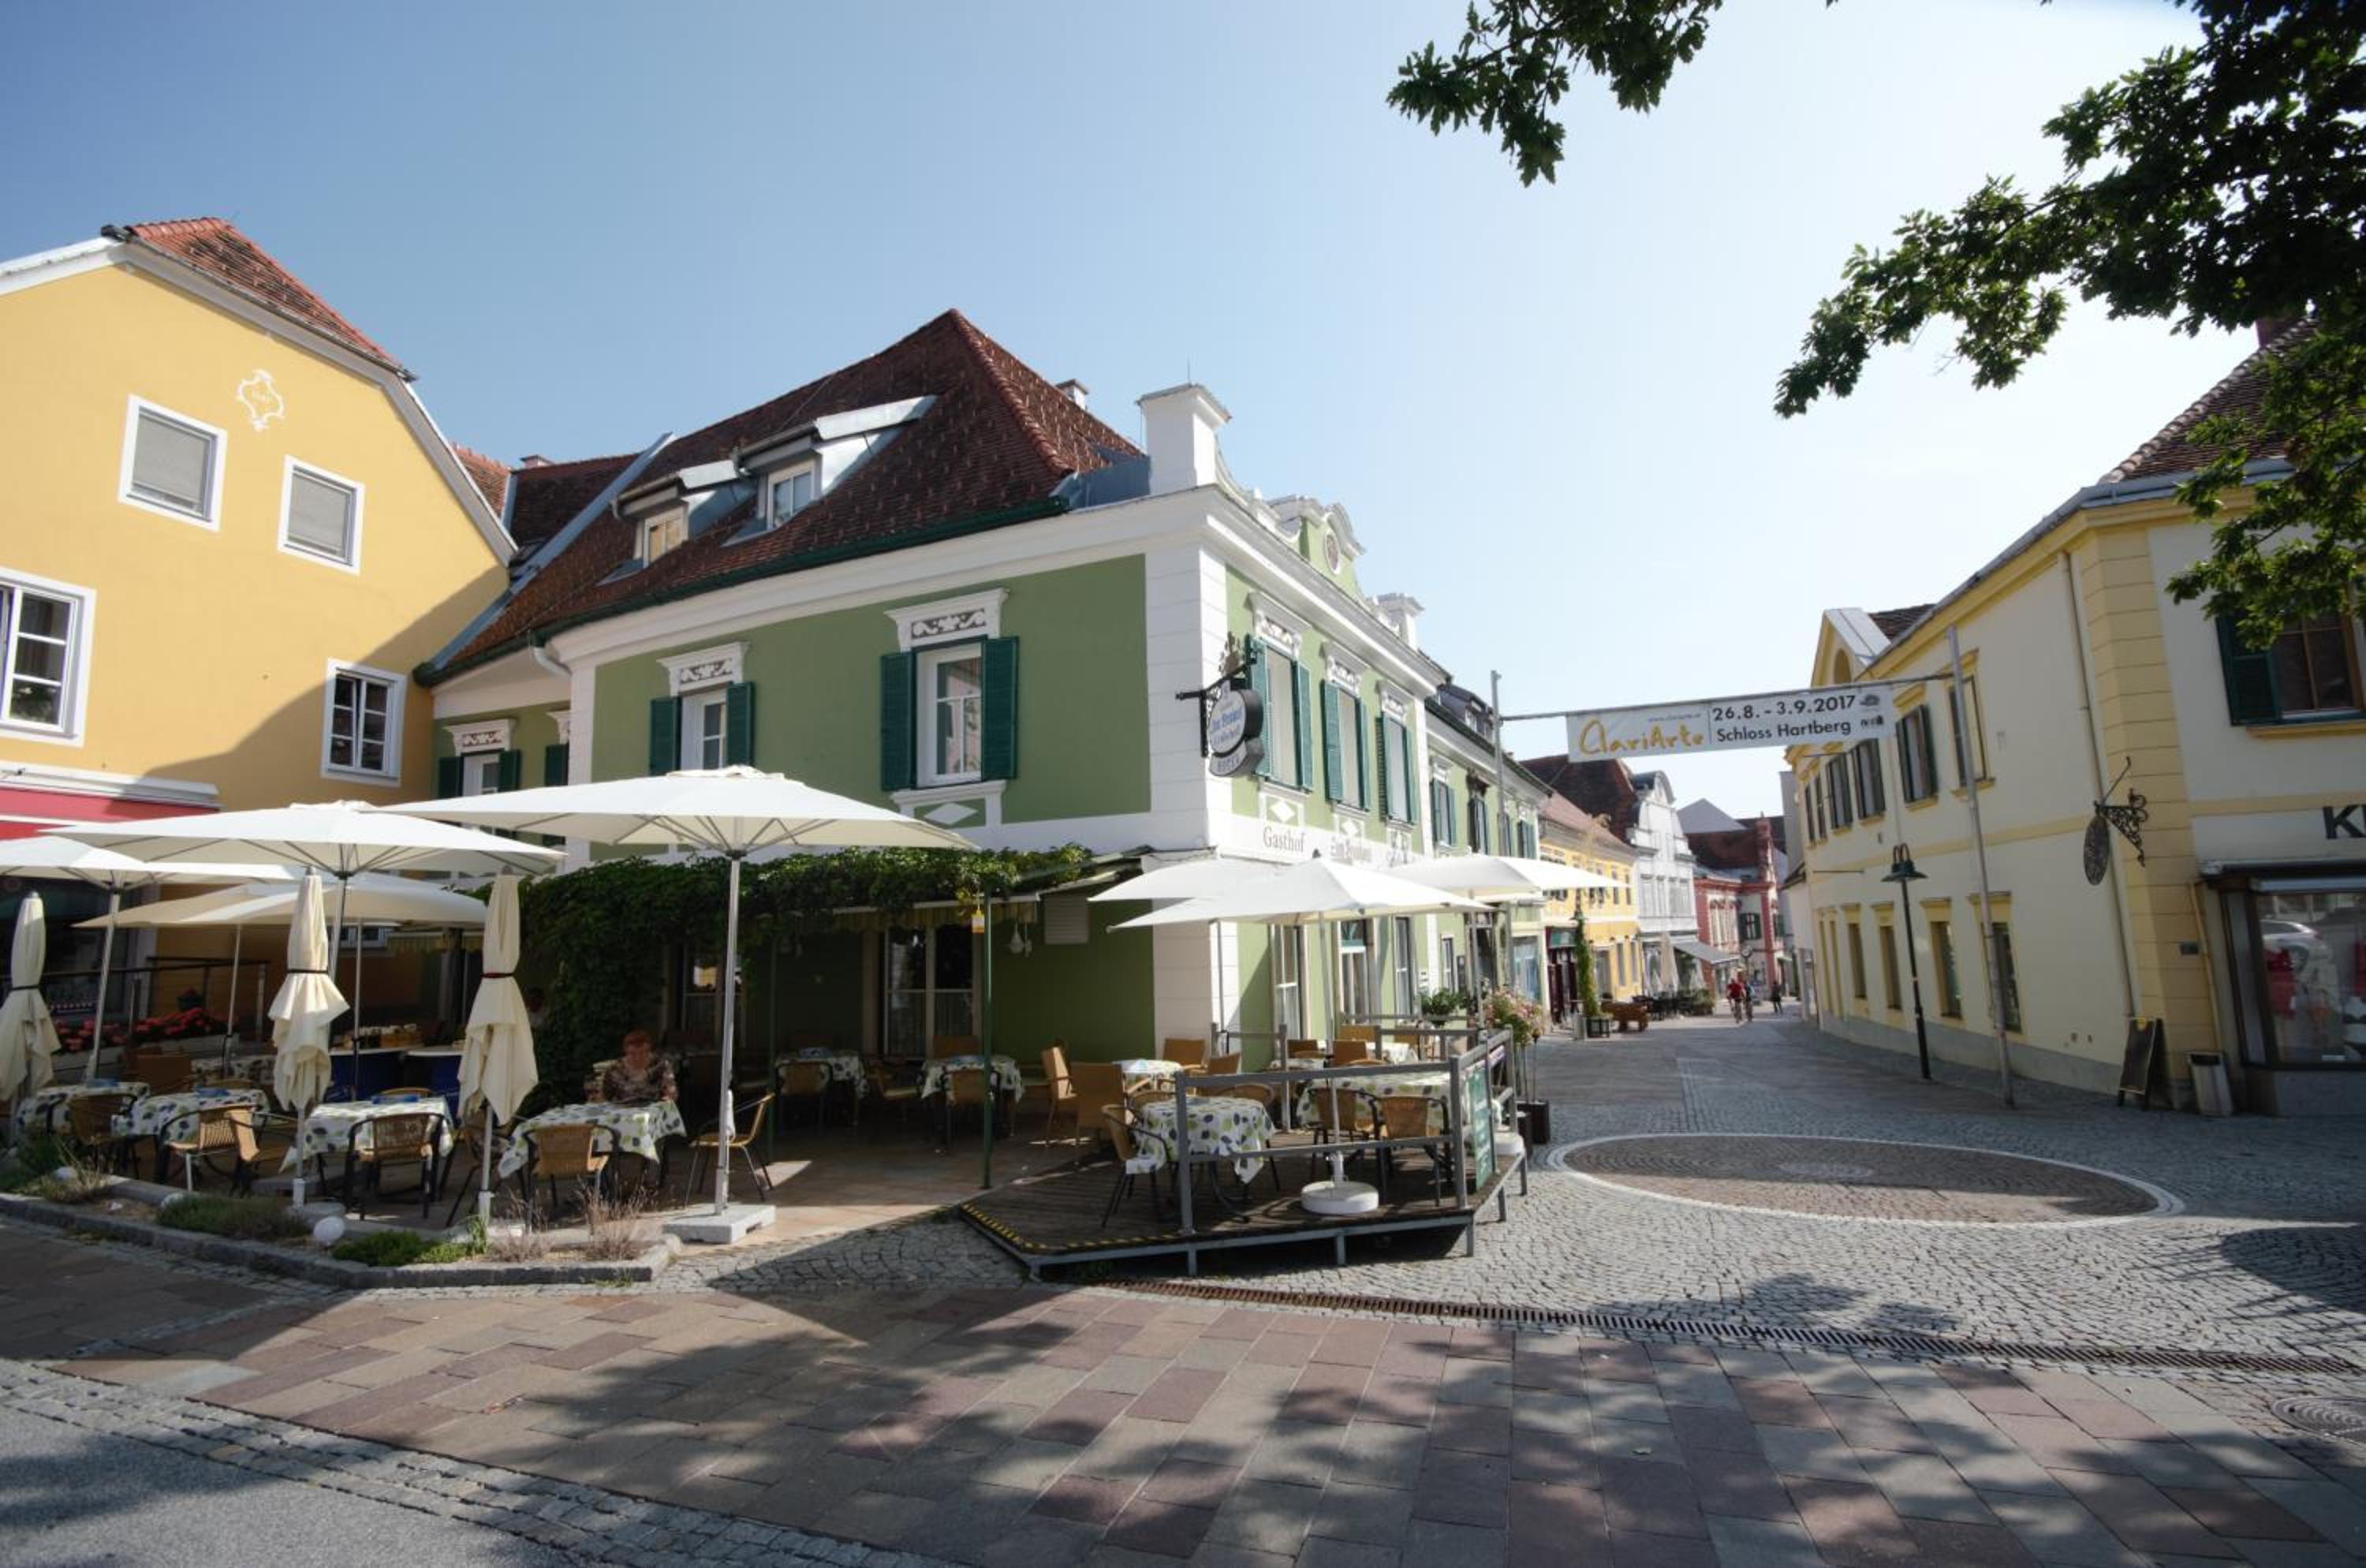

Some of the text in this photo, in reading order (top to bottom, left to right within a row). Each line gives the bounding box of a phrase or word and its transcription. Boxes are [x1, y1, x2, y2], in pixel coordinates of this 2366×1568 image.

[1717, 726, 1773, 743] Schloss
[1777, 720, 1852, 736] Hartberg
[1263, 826, 1306, 853] Gasthof
